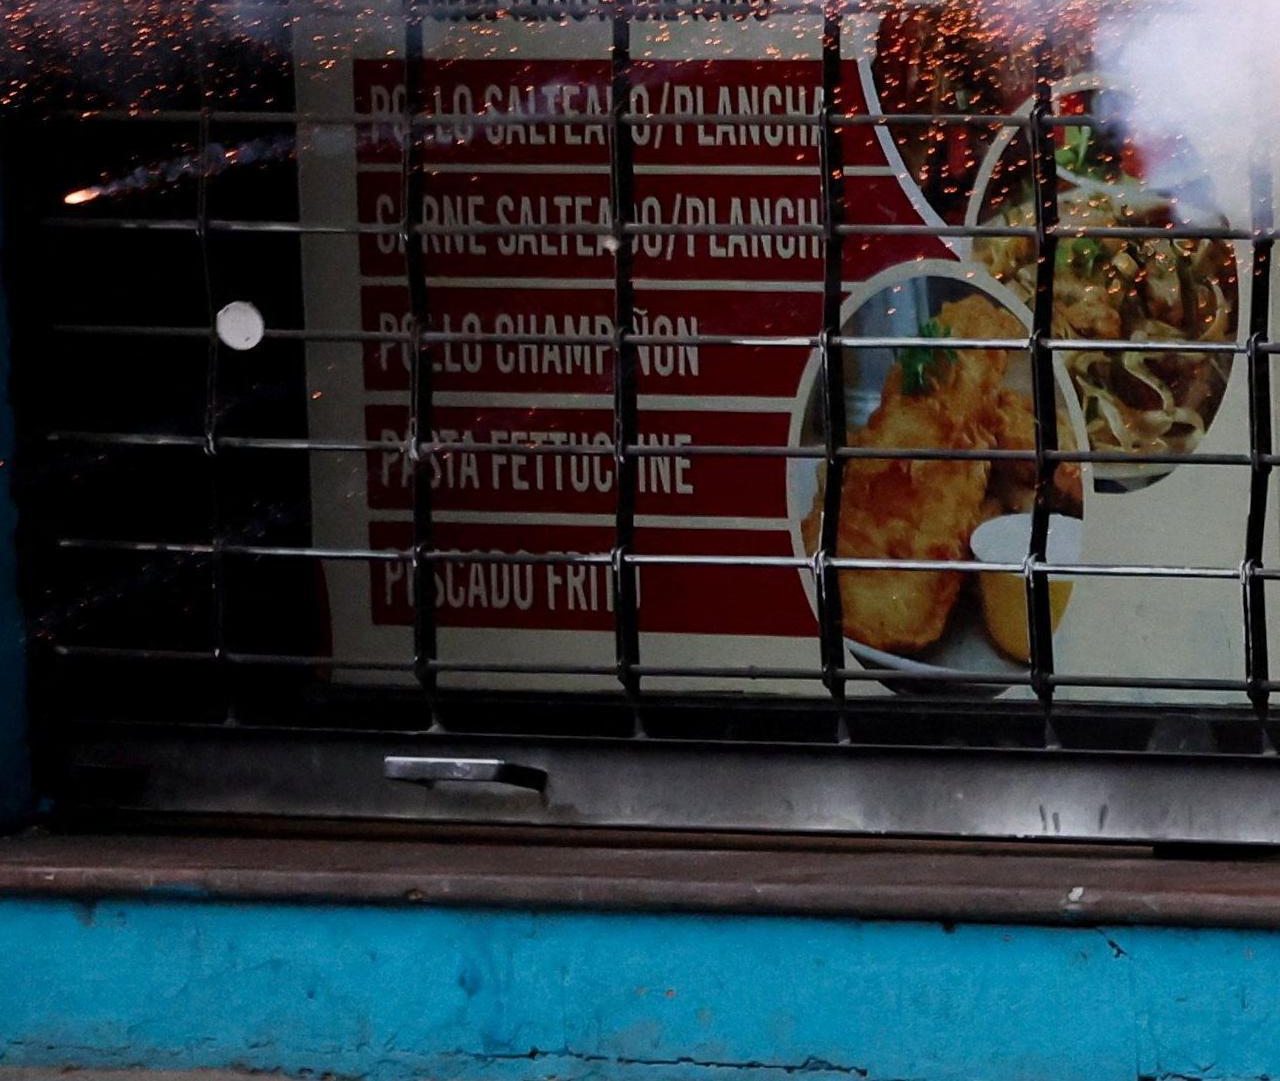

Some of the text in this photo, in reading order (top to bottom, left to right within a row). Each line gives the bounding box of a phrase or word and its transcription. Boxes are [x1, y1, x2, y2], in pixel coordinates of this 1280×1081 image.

[369, 83, 474, 146] POLO
[376, 191, 827, 262] CRNE SALTEAO/PLANCH
[379, 306, 700, 377] POLO CHAMPÑON
[489, 429, 695, 495] FETTUCINE
[545, 550, 642, 613] FRIT
